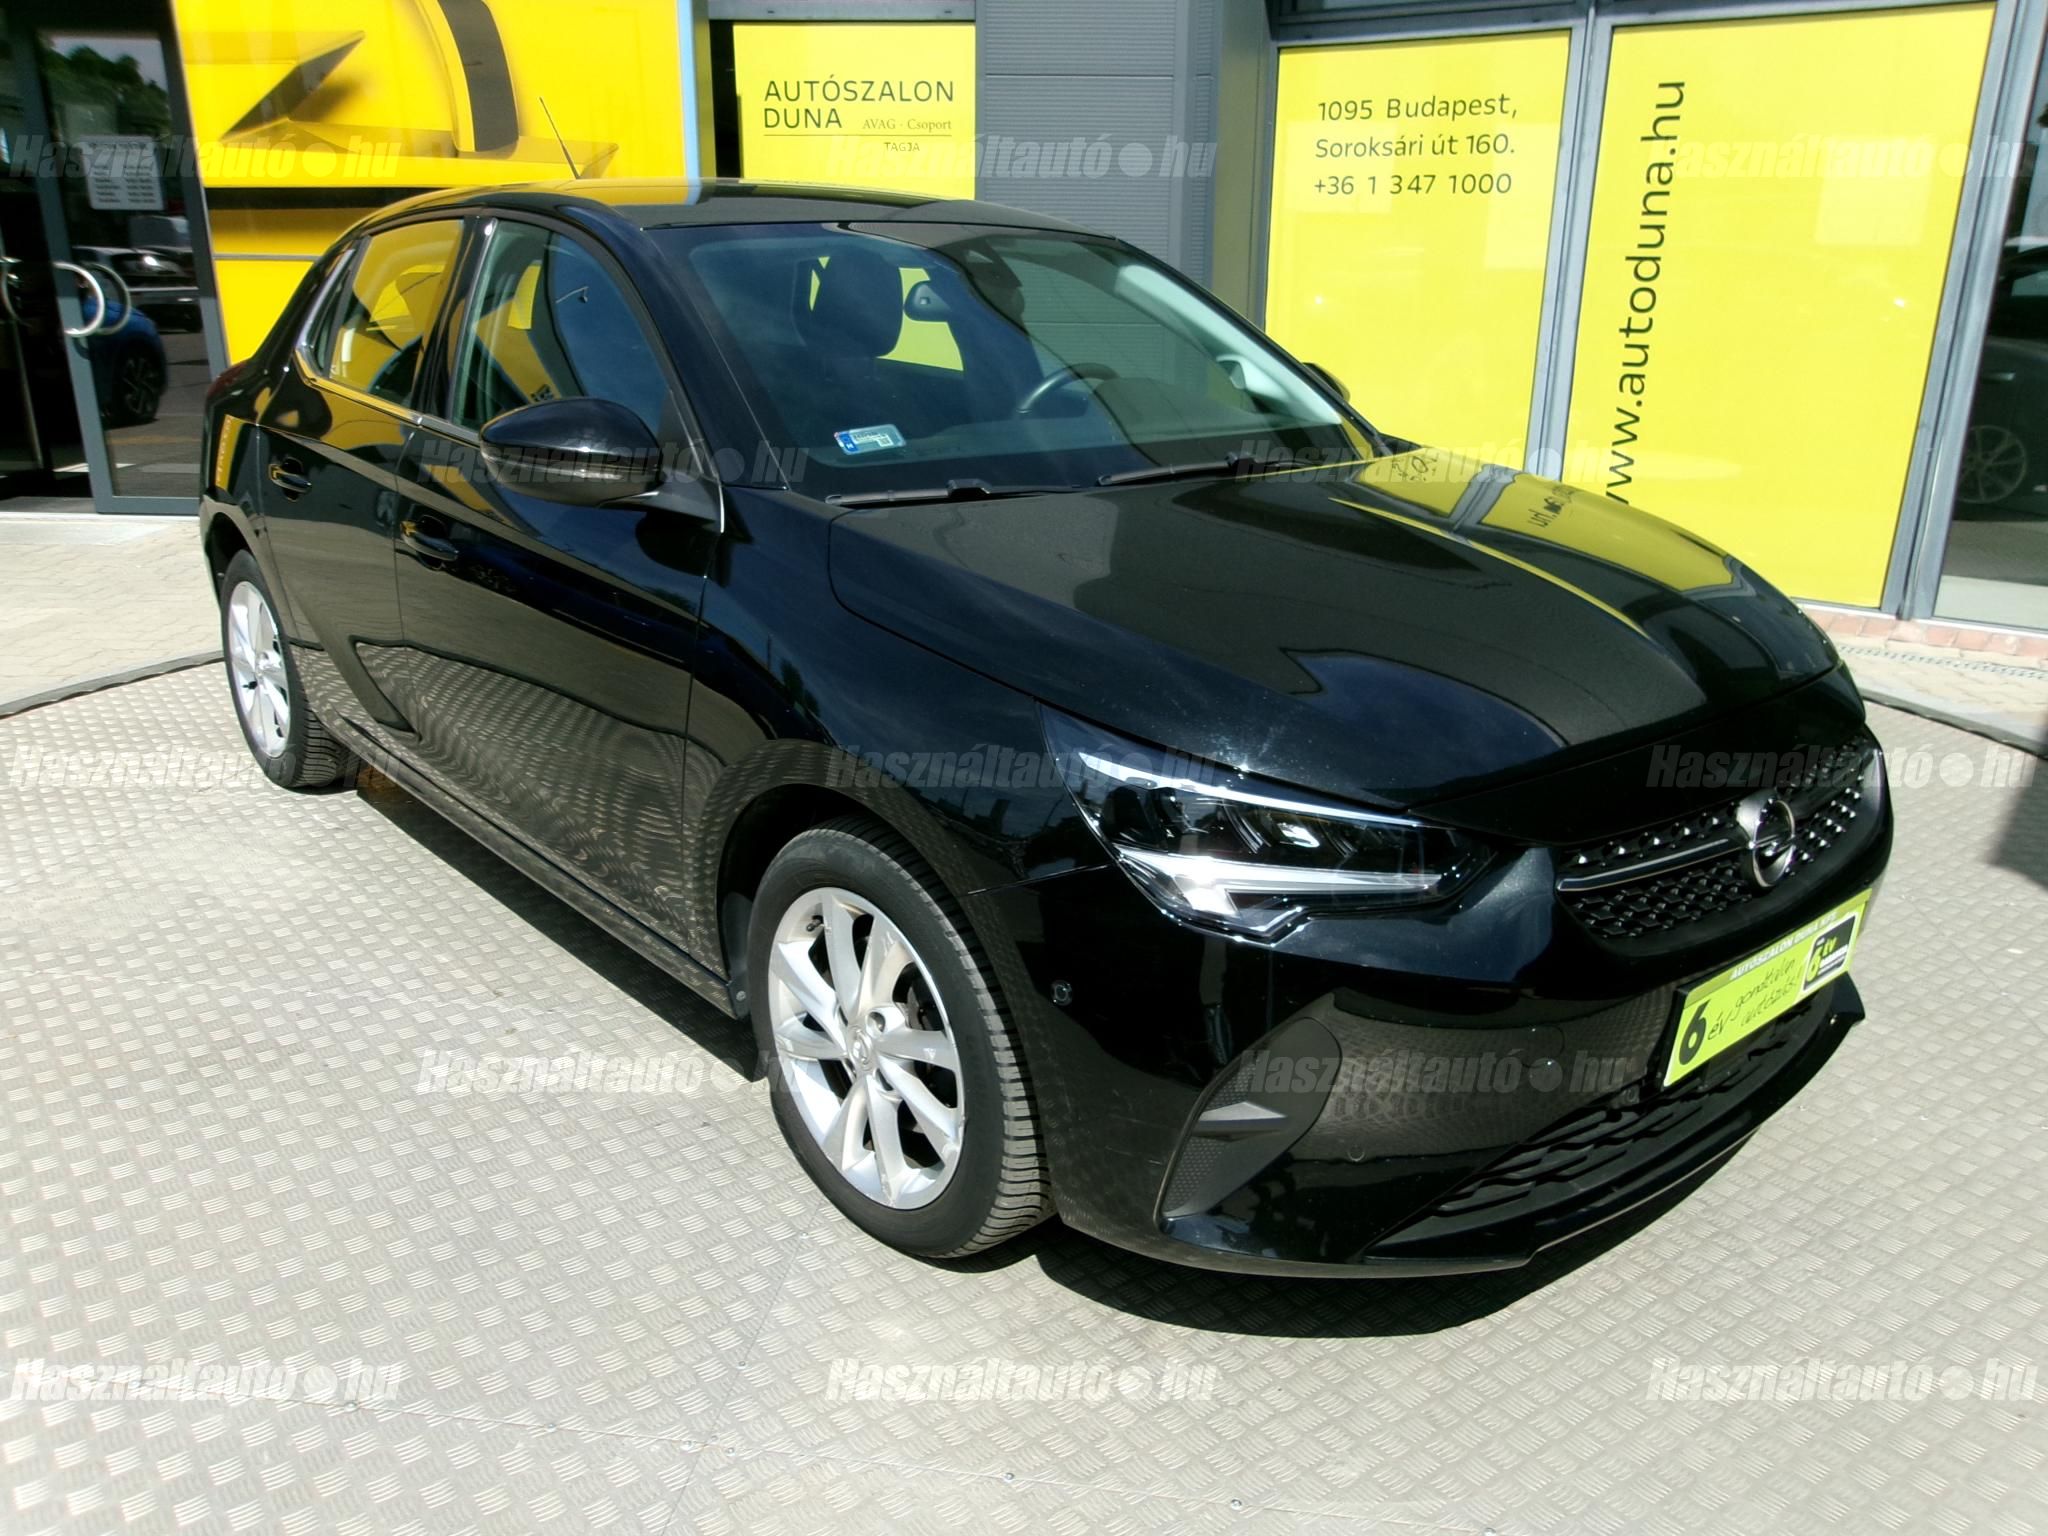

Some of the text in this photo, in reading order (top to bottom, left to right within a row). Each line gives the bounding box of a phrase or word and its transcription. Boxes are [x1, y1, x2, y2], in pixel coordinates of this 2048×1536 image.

[764, 74, 954, 102] AUTÓSZALON
[763, 107, 843, 129] DUNA
[1317, 93, 1517, 121] 1095 Budapest,
[862, 118, 952, 133] AVAG Csoport
[884, 142, 920, 152] TAGJA
[1315, 133, 1515, 158] Soroksári út 160.
[1314, 173, 1512, 195] +36 1 347 1000
[1605, 80, 1686, 505] ww.autoduna.hu
[1678, 999, 1712, 1066] 6
